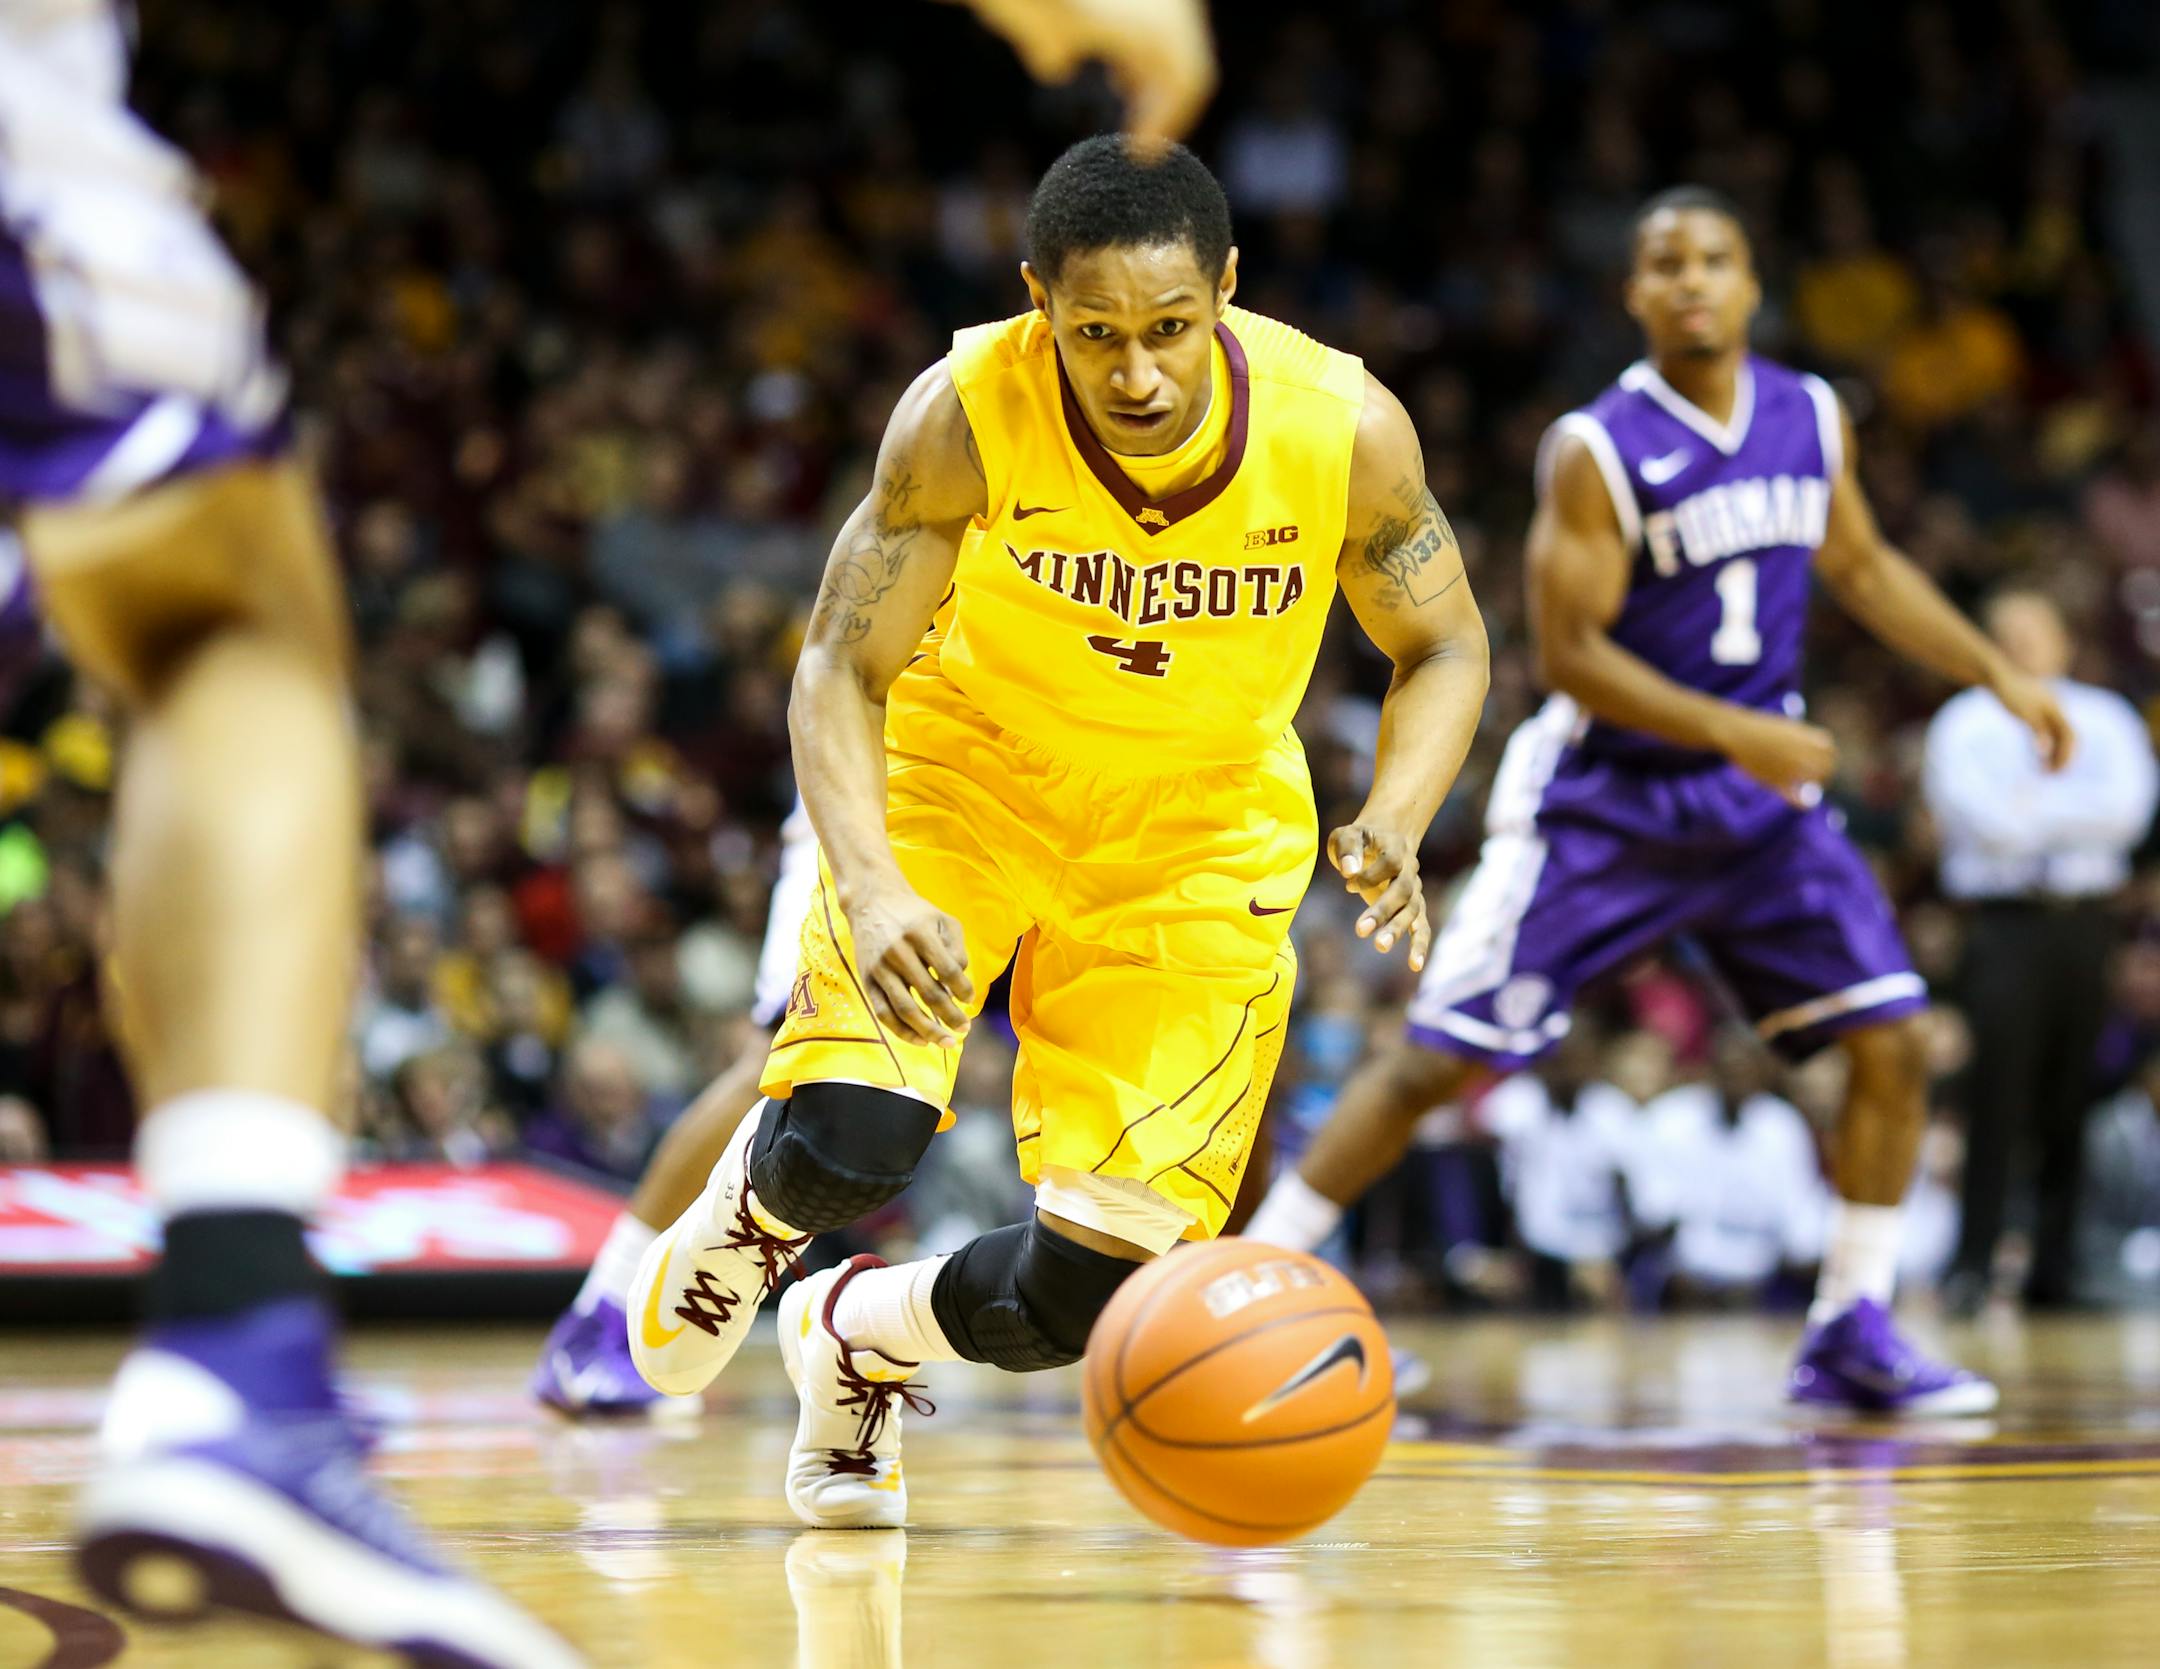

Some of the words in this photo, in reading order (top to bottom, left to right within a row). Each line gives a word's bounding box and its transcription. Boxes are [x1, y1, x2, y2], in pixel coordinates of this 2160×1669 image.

[1412, 528, 1441, 563] 33
[1005, 543, 1304, 626] MINNESOTA
[1711, 558, 1762, 665] 1
[1086, 634, 1172, 677] 4
